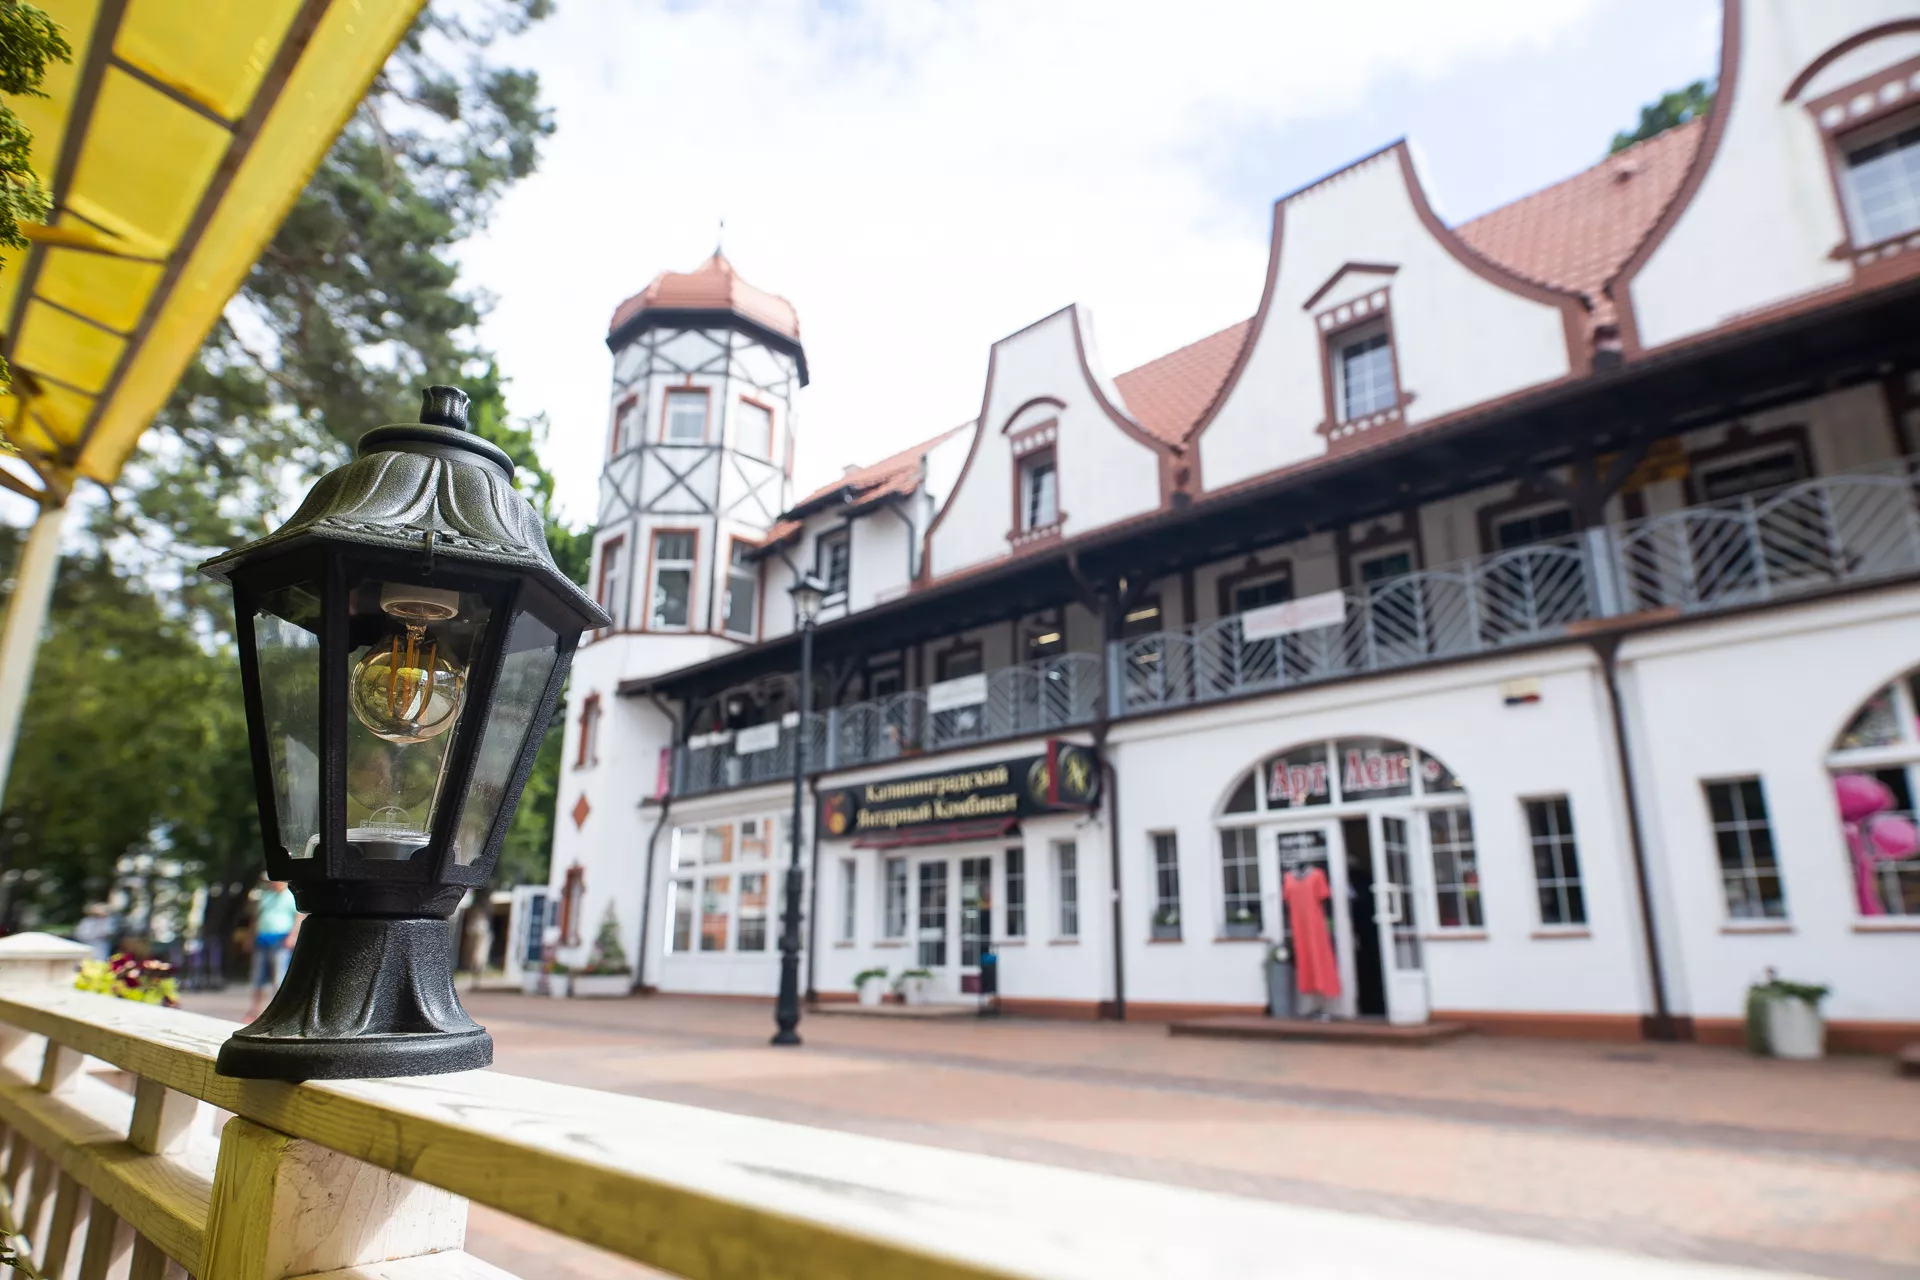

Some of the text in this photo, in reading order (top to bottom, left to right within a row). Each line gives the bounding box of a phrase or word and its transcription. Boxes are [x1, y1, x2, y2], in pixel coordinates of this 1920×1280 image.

[865, 765, 1009, 803] Калининградский
[1269, 762, 1327, 806] Арт
[856, 793, 1018, 830] Янтарный Комбинат
